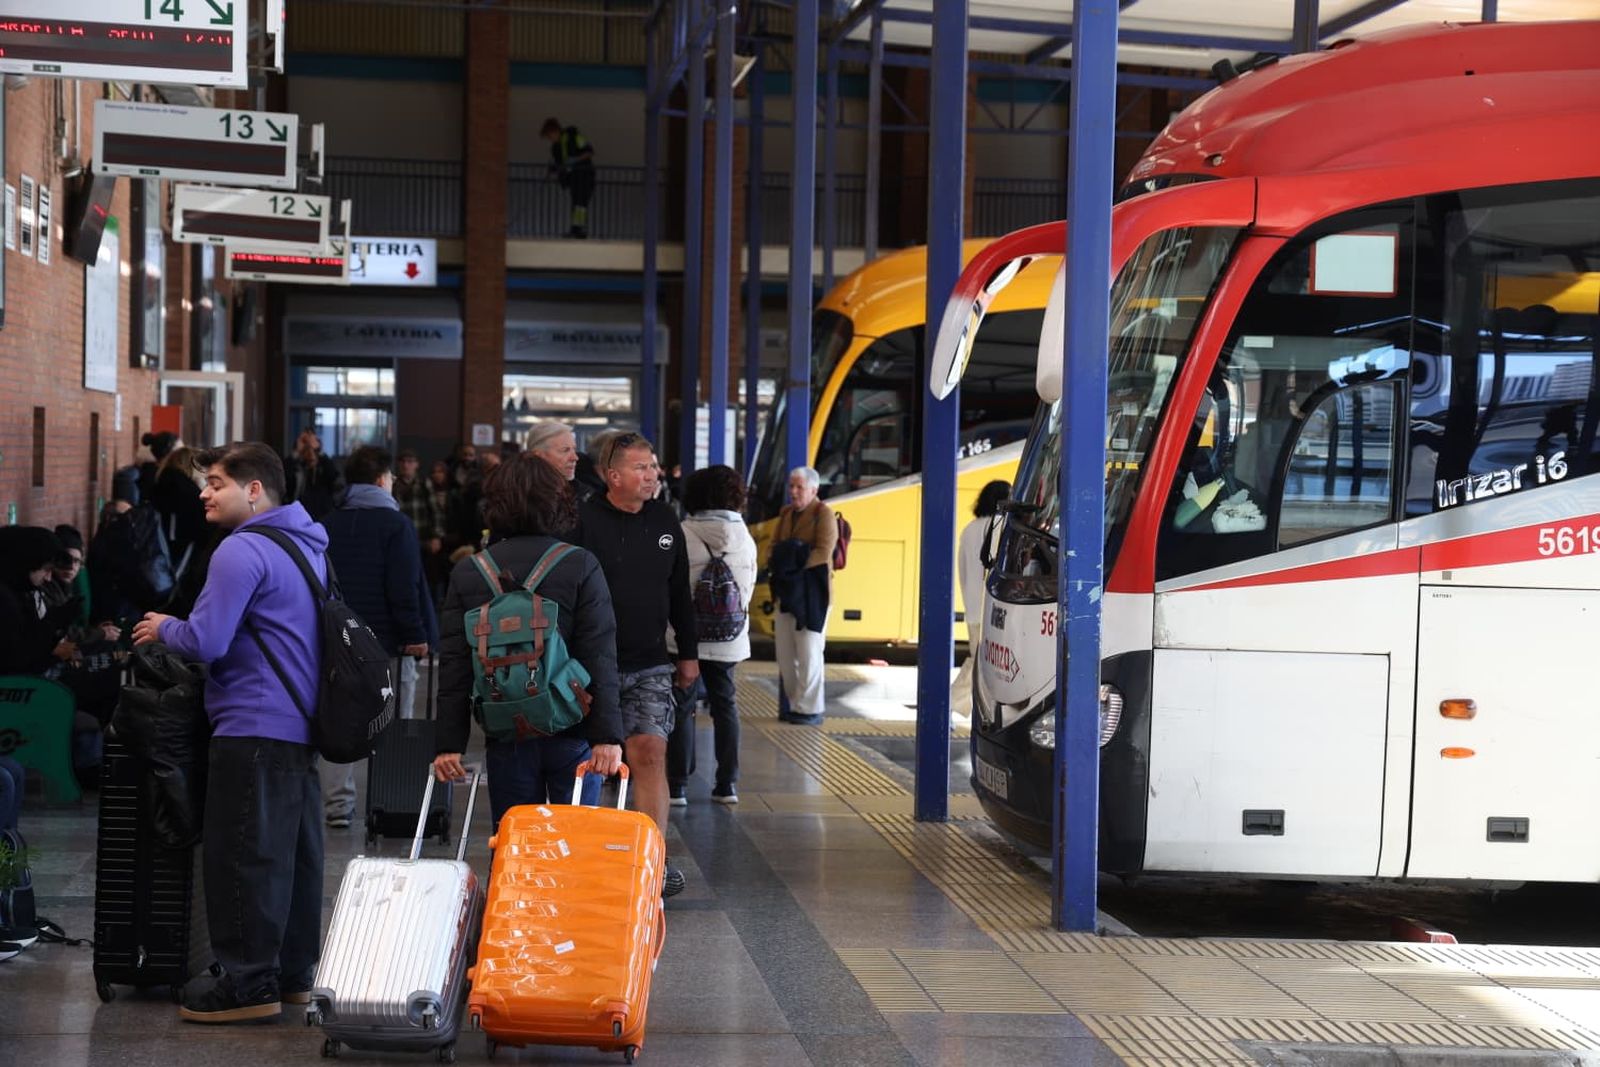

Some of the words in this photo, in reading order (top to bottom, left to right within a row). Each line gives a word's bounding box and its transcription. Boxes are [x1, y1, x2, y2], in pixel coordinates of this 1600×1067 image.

[219, 112, 254, 140] 13
[268, 196, 296, 216] 12
[1436, 463, 1528, 508] Irizar
[1535, 451, 1568, 484] i6
